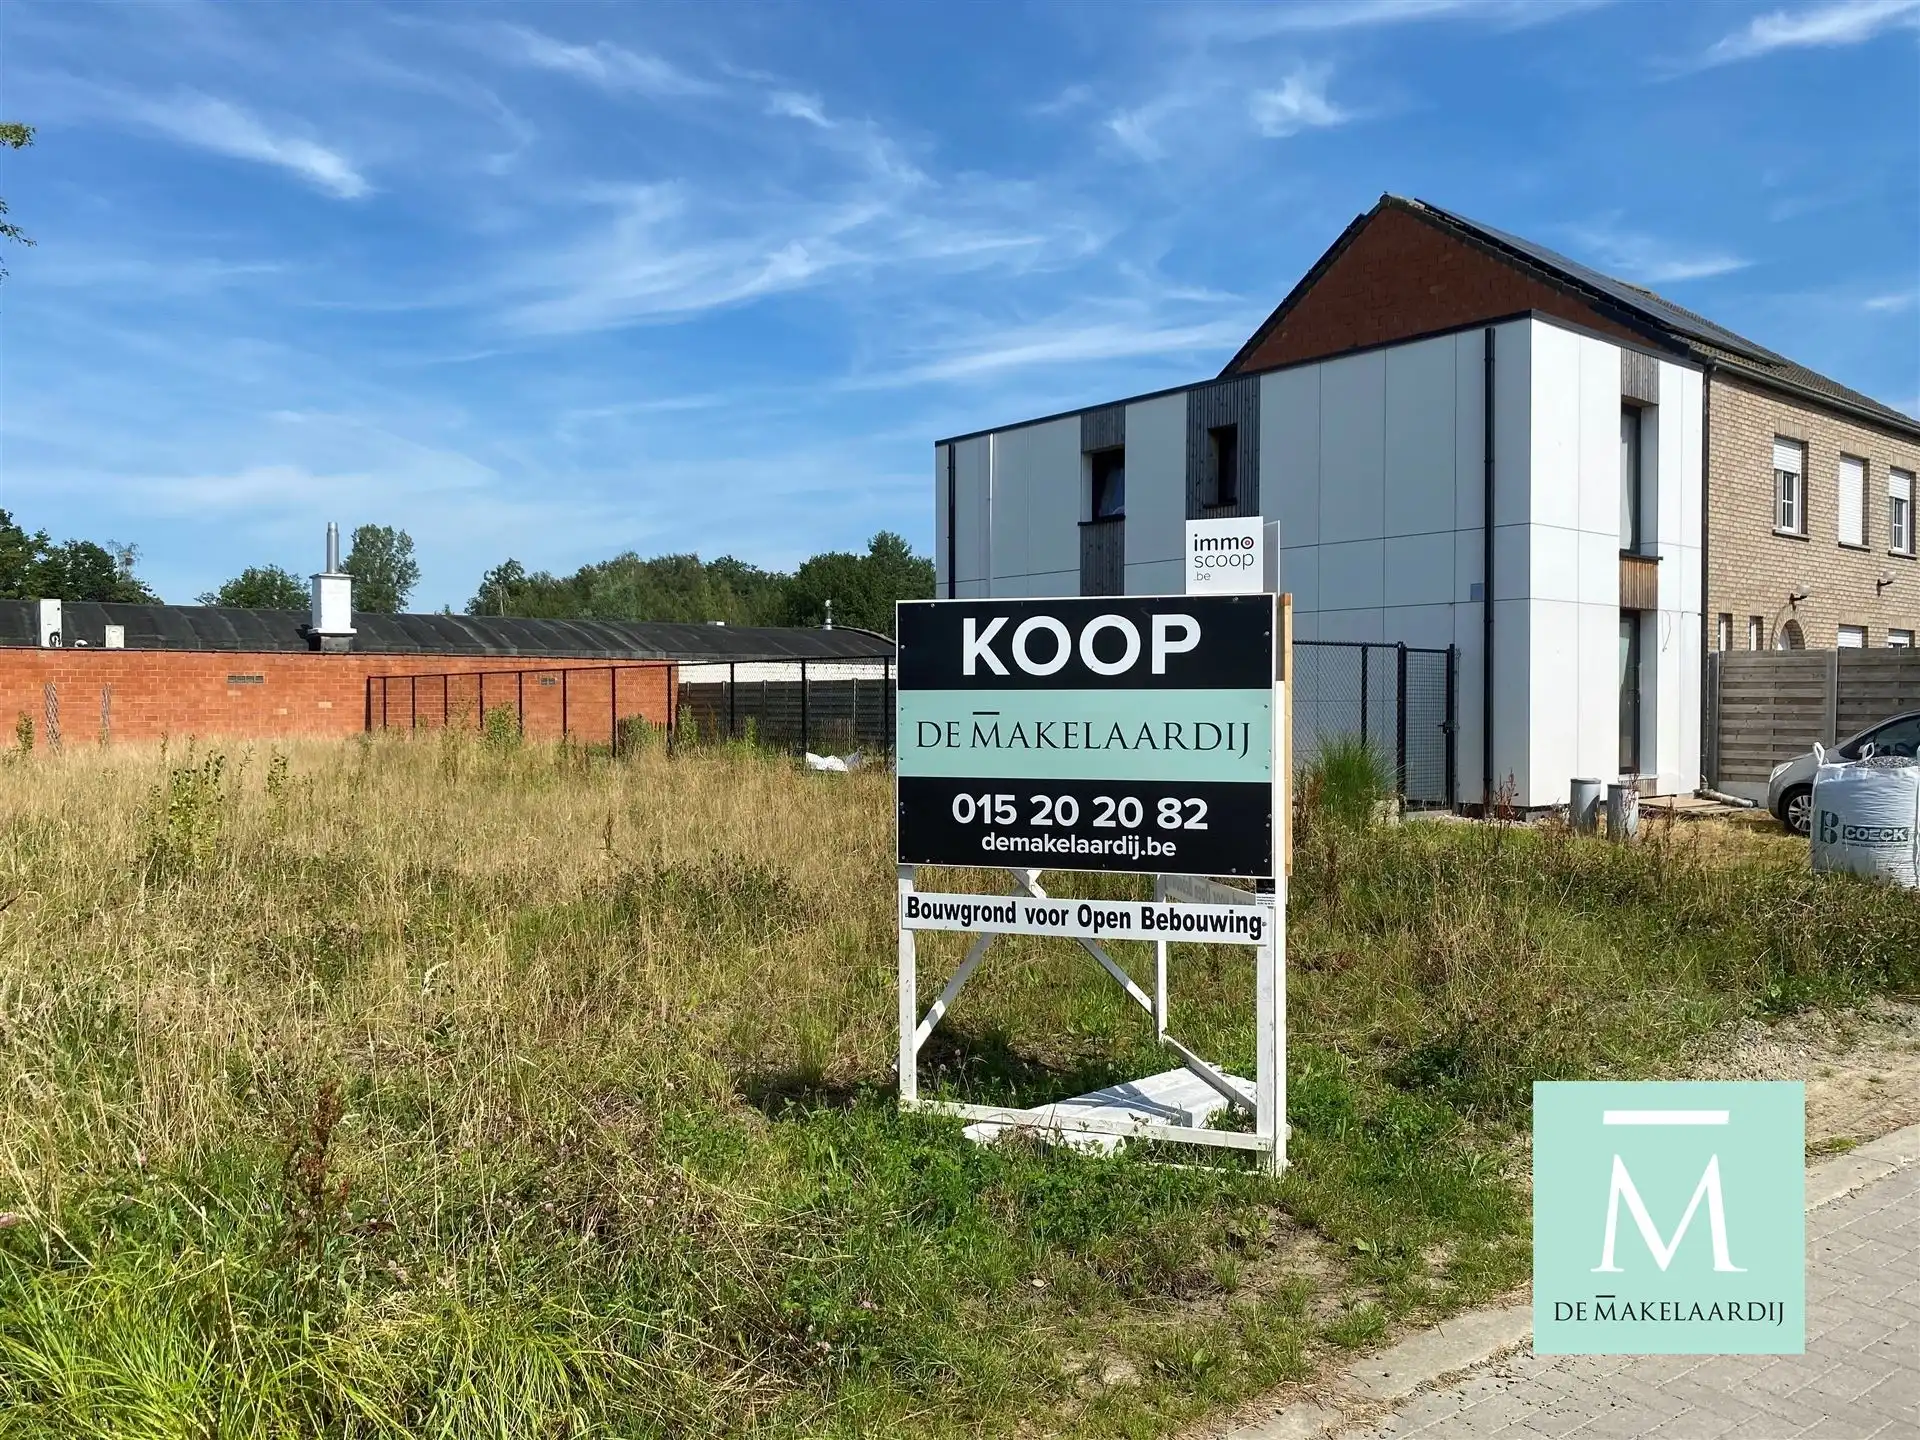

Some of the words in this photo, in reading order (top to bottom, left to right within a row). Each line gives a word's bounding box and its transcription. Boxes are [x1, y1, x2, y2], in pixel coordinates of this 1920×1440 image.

[1194, 533, 1254, 552] immo
[1194, 553, 1254, 570] scoop
[962, 613, 1201, 676] KOOP
[917, 721, 960, 748] DE
[969, 711, 1250, 759] MAKELAARDIJ
[952, 792, 1018, 826] 015
[1030, 795, 1080, 828] 20
[1092, 797, 1144, 829] 20
[1156, 797, 1208, 830] 82
[981, 831, 1177, 860] demakelaardij.be
[1845, 826, 1907, 841] COECK
[906, 896, 1017, 927] Bouwgrond
[1025, 908, 1069, 926] voor
[1077, 904, 1131, 933] Open
[1141, 910, 1262, 940] Bebouwing
